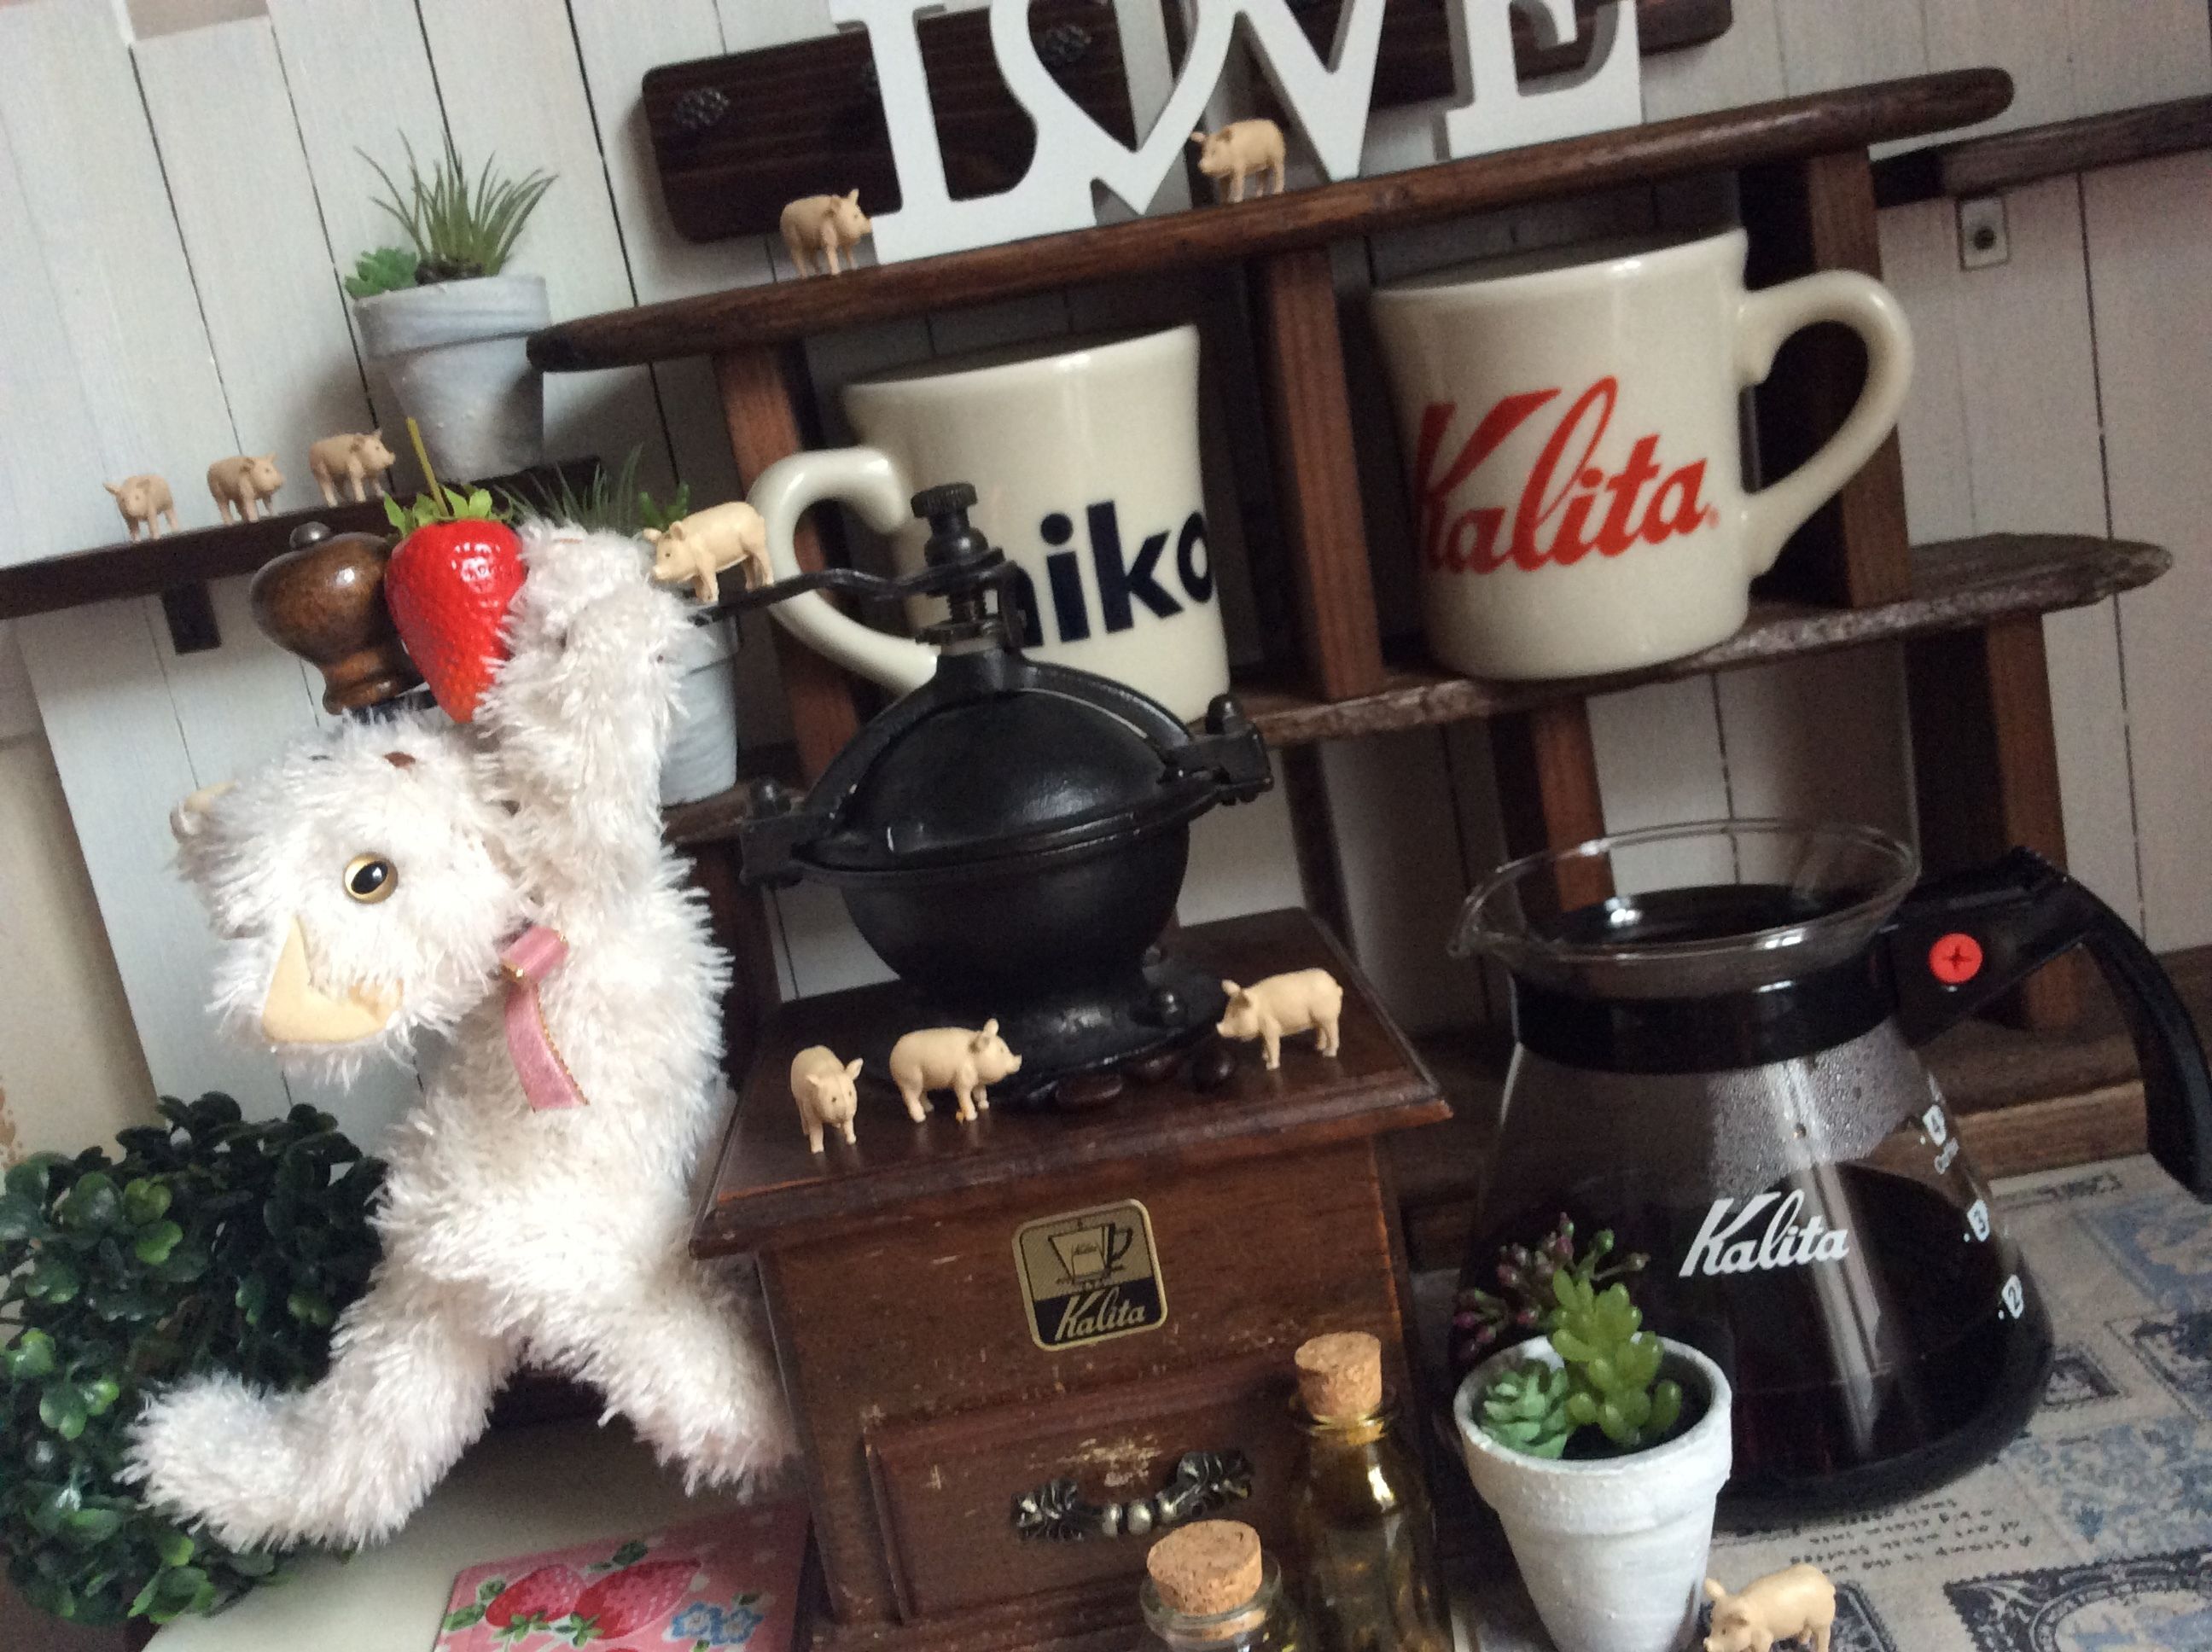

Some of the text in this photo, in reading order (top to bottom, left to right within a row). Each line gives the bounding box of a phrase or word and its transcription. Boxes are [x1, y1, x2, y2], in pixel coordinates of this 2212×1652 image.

[1414, 375, 1709, 575] Kalita
[1679, 1189, 1850, 1277] Kalita
[1054, 1285, 1146, 1341] Kalita
